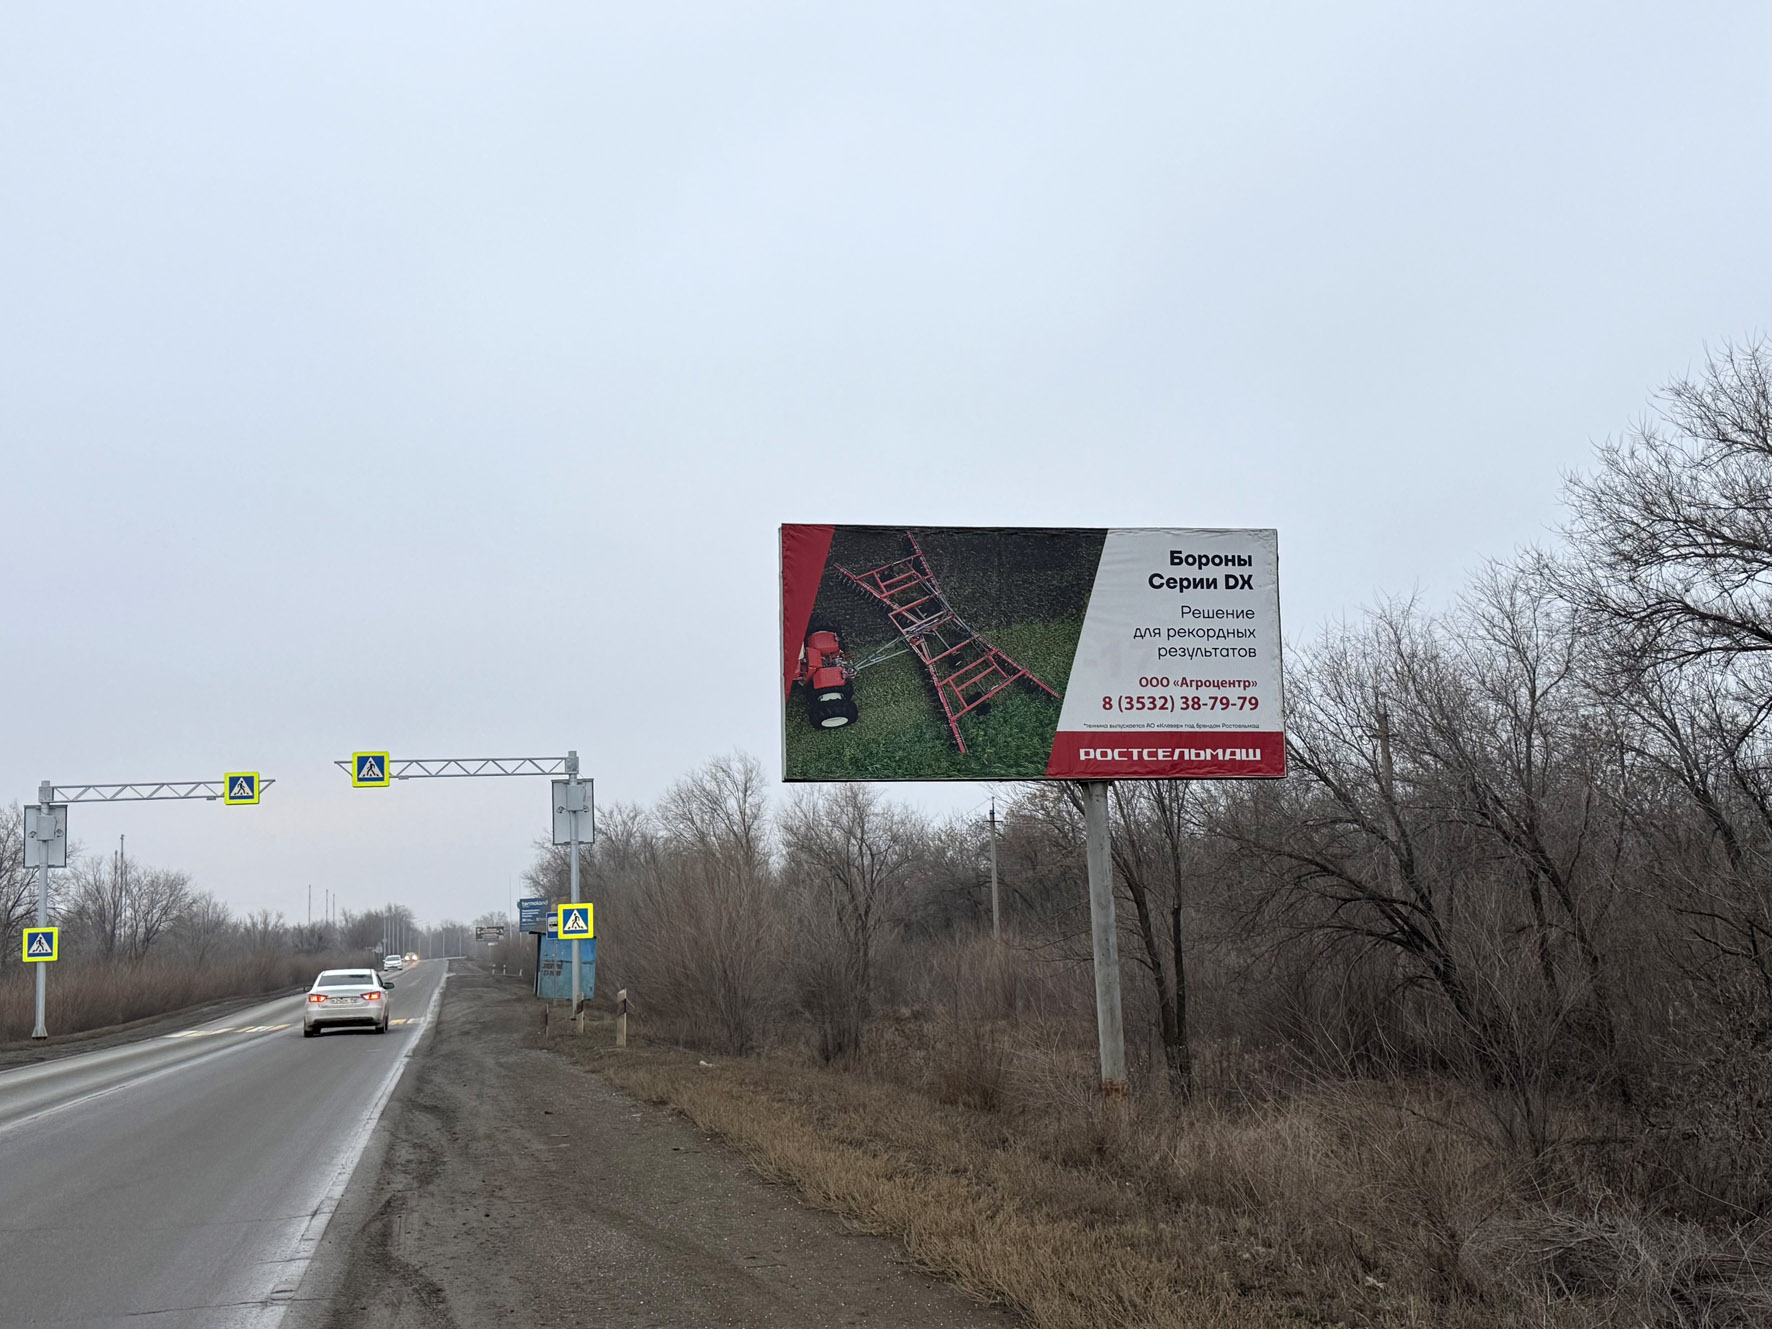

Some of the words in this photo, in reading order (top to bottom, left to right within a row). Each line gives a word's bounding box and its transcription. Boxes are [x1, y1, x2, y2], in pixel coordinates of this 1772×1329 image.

[1169, 550, 1253, 570] Бороны
[1148, 573, 1218, 593] Серии
[1224, 574, 1254, 590] DX
[1181, 605, 1255, 619] Решение
[1133, 627, 1161, 639] для
[1167, 627, 1256, 641] рекордных
[1158, 646, 1257, 660] результатов
[1138, 676, 1170, 689] ООО
[1173, 677, 1258, 690] «Агроцентр»
[1102, 696, 1113, 711] 8
[1117, 695, 1175, 713] (3532)
[1180, 696, 1259, 711] 38-79-79
[1079, 748, 1262, 761] РОСТСЕЛЬМАШ
